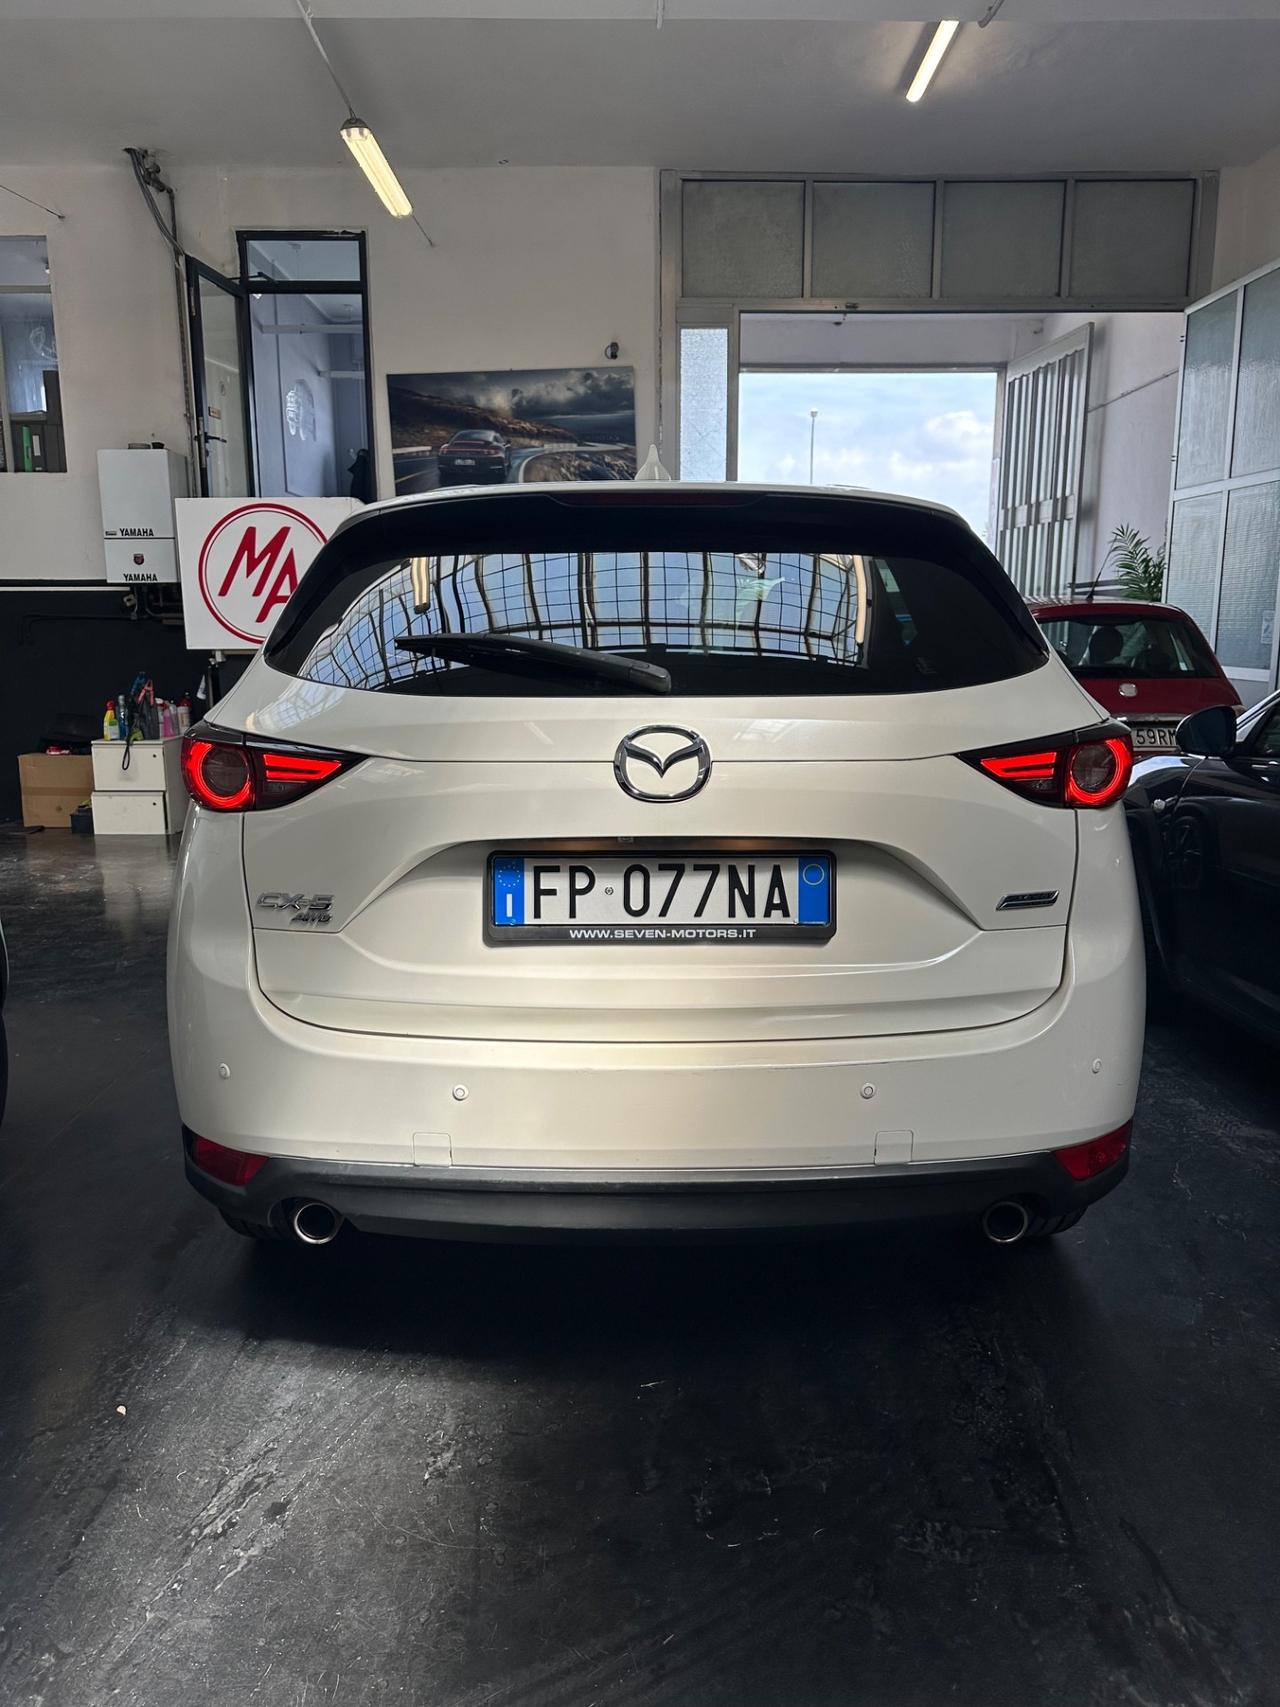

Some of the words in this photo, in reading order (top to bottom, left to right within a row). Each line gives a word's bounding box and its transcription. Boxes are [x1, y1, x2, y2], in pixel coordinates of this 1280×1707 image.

[119, 527, 155, 537] YAMAHA
[123, 573, 158, 582] YAMAHA
[218, 526, 299, 623] MA
[532, 864, 596, 920] FP
[623, 863, 791, 919] 077NA
[256, 892, 335, 911] CX-5
[569, 928, 757, 939] WWW.SEVEN-MOTORS.IT
